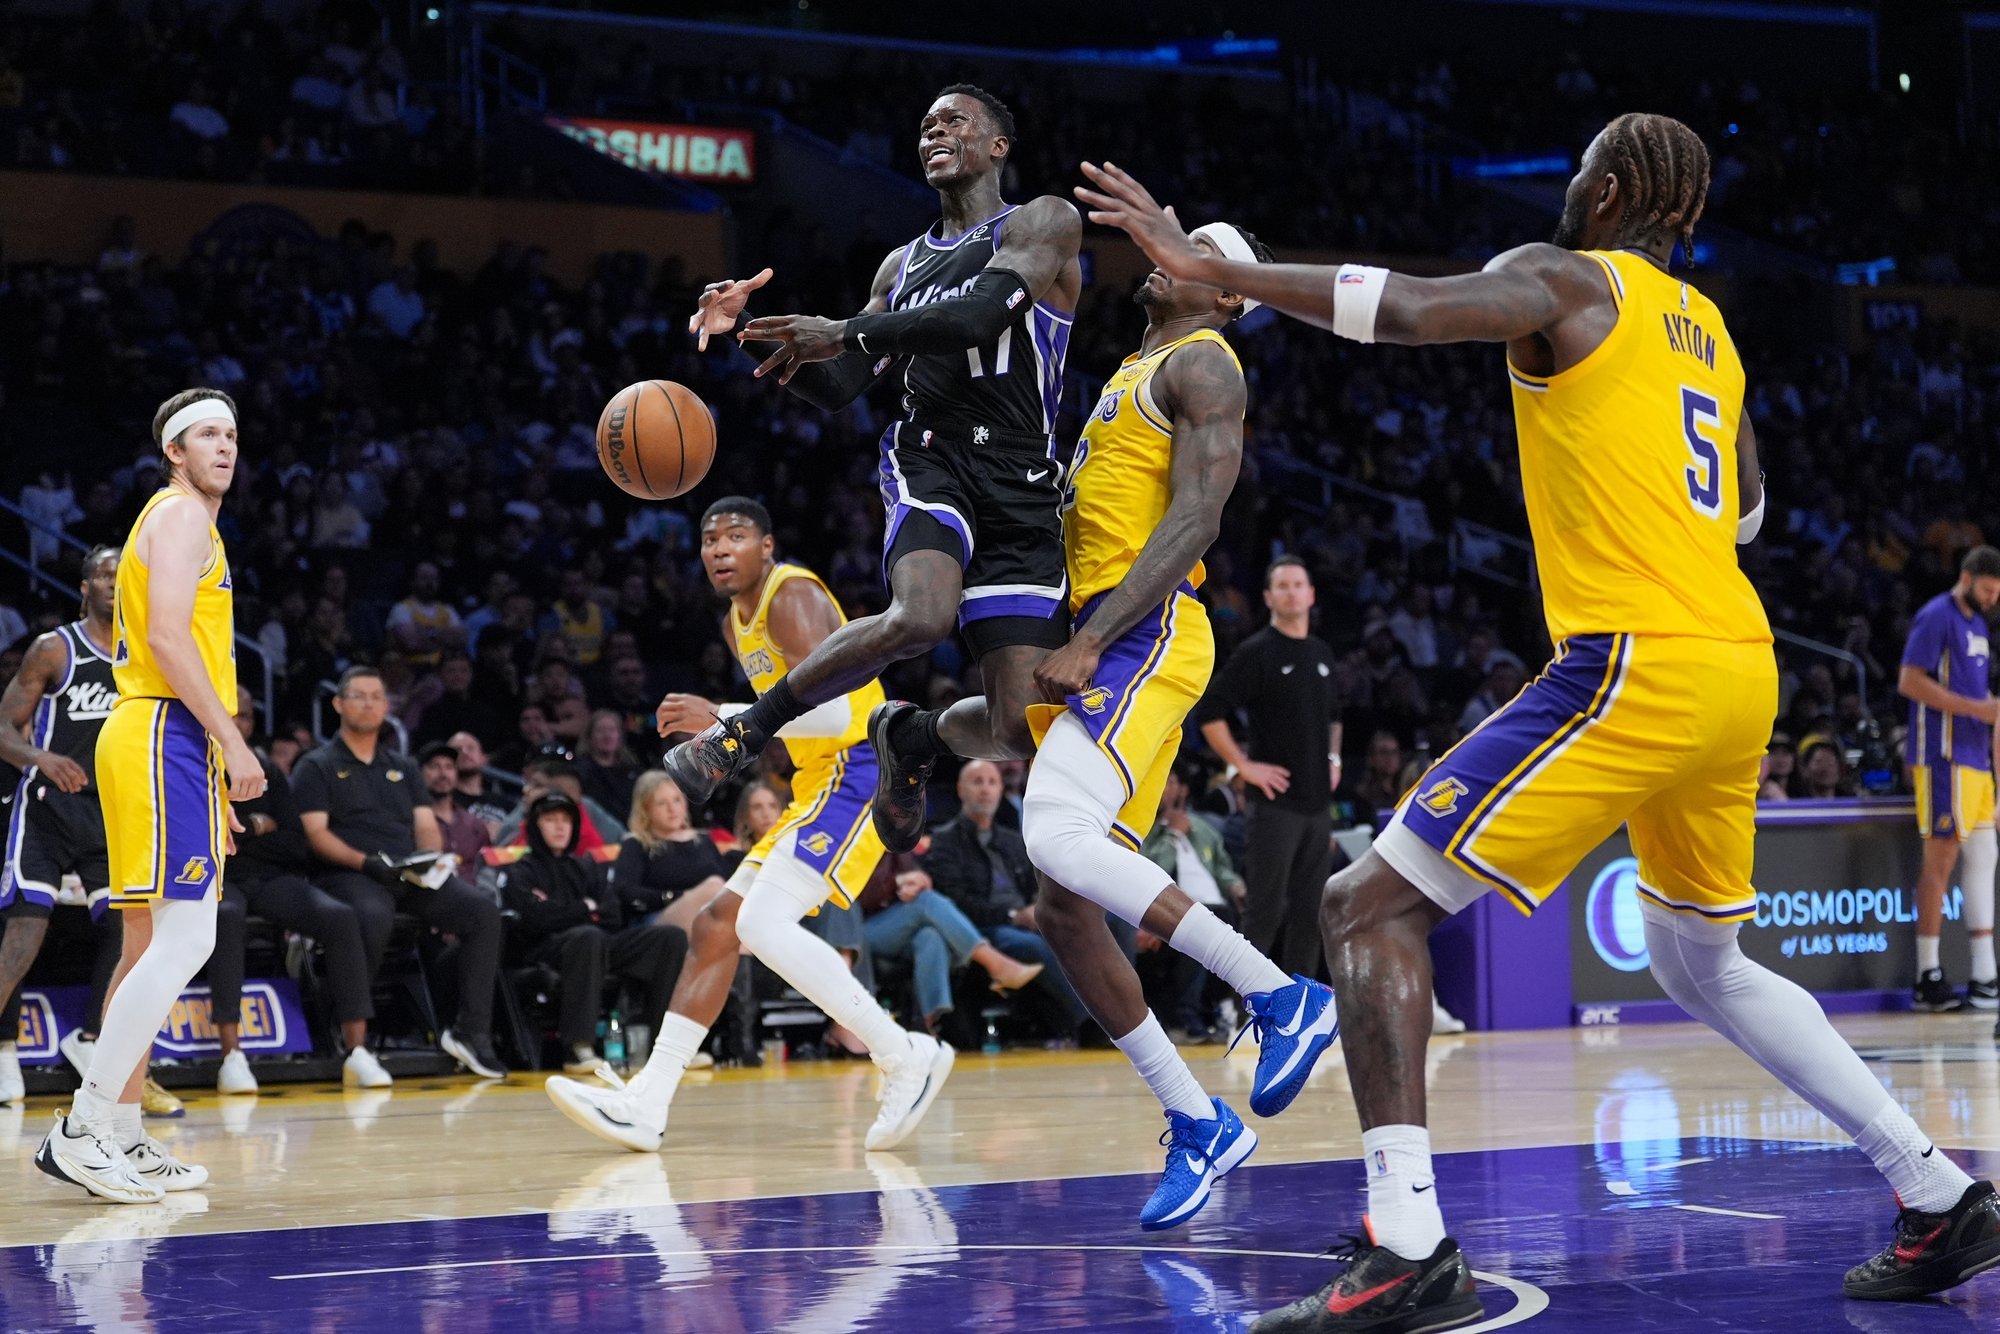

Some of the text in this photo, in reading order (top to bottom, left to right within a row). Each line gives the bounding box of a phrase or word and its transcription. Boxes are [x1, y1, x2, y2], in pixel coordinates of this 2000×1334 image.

[560, 125, 751, 179] OSHIBA
[1663, 313, 1716, 371] AYTON
[608, 405, 632, 484] Wilson
[1679, 384, 1723, 520] 5
[1781, 932, 1888, 959] of LAS VEGAS
